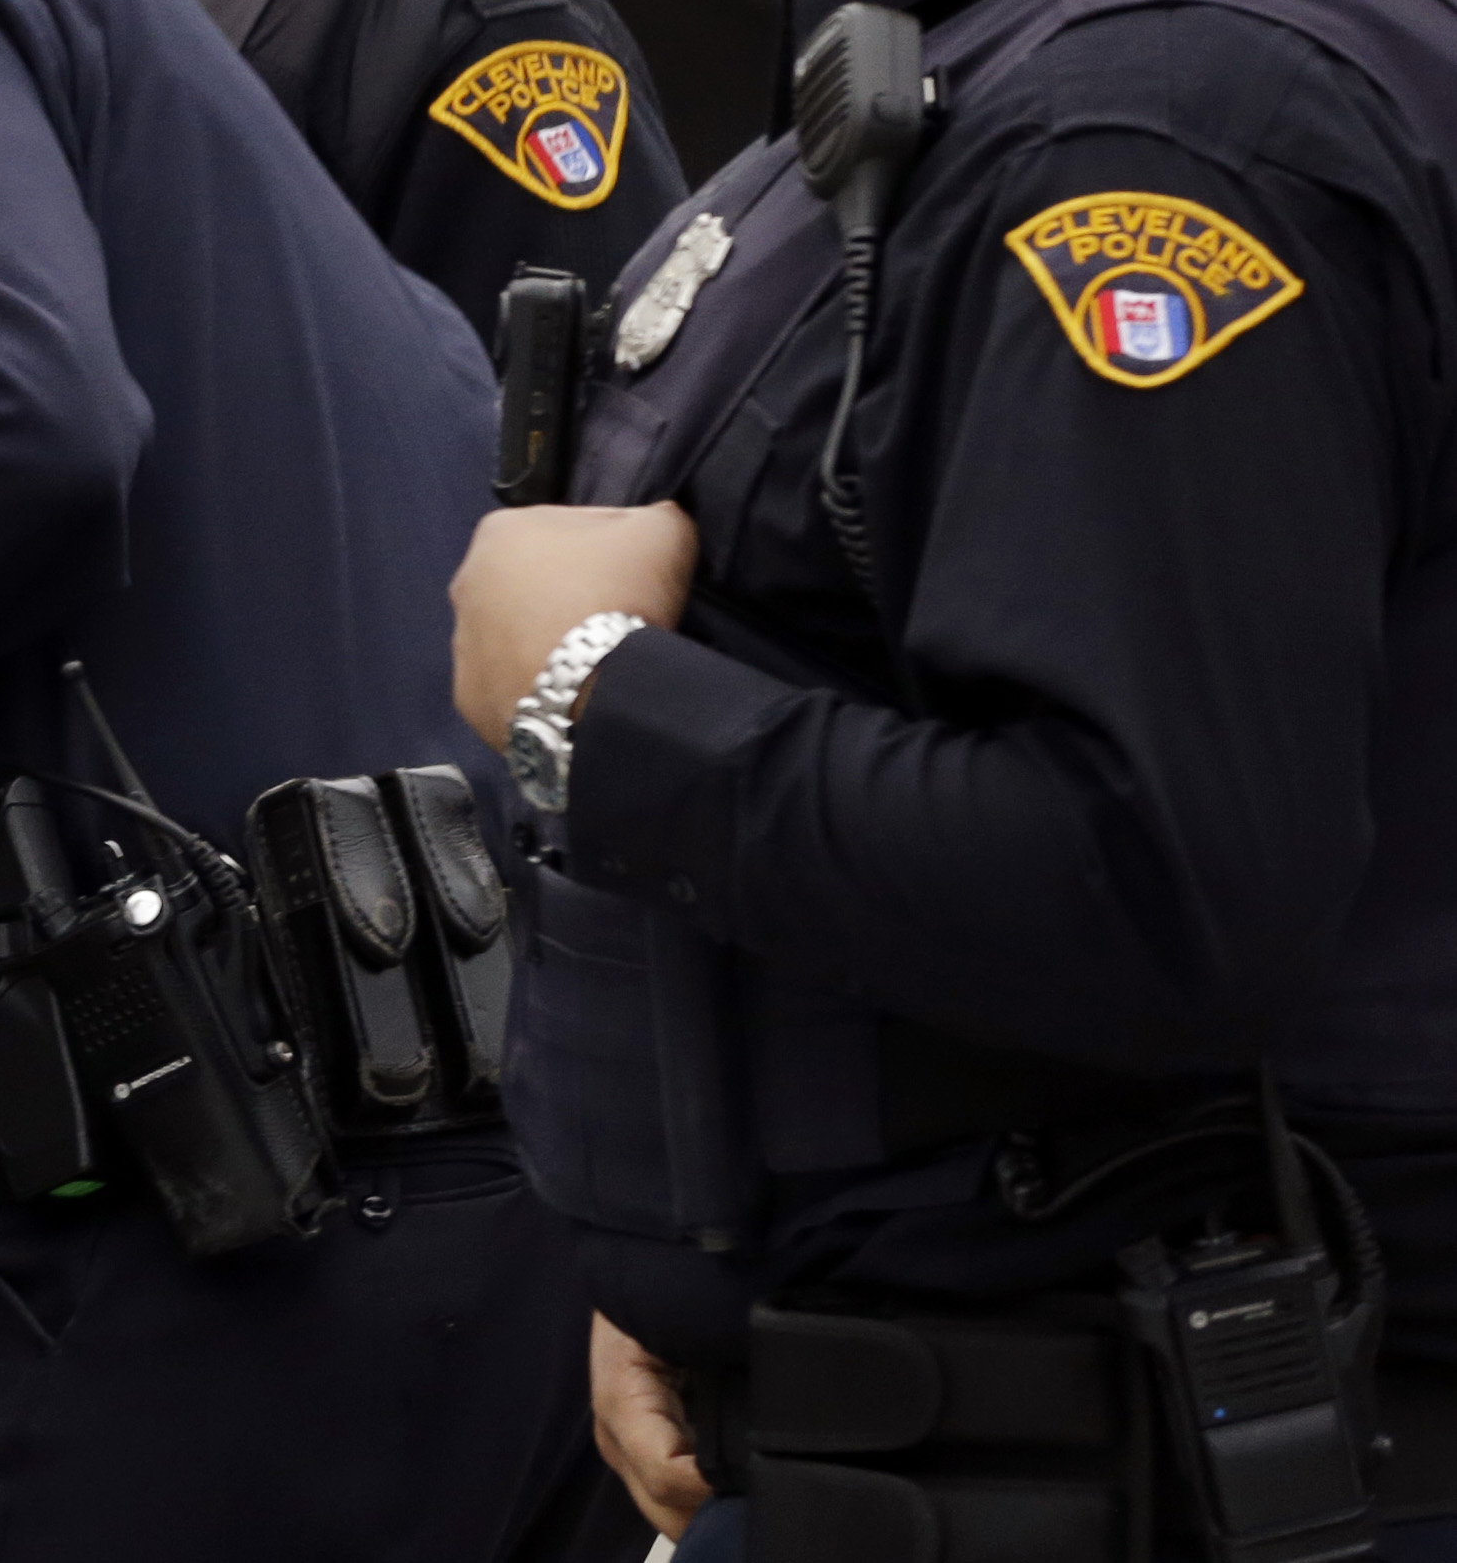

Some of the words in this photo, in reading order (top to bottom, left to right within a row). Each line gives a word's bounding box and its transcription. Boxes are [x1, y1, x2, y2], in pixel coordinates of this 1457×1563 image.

[451, 52, 616, 116] CLEVELAND
[487, 76, 601, 125] POLICE
[1034, 205, 1272, 290] CLEVELAND
[1069, 233, 1235, 297] POLICE
